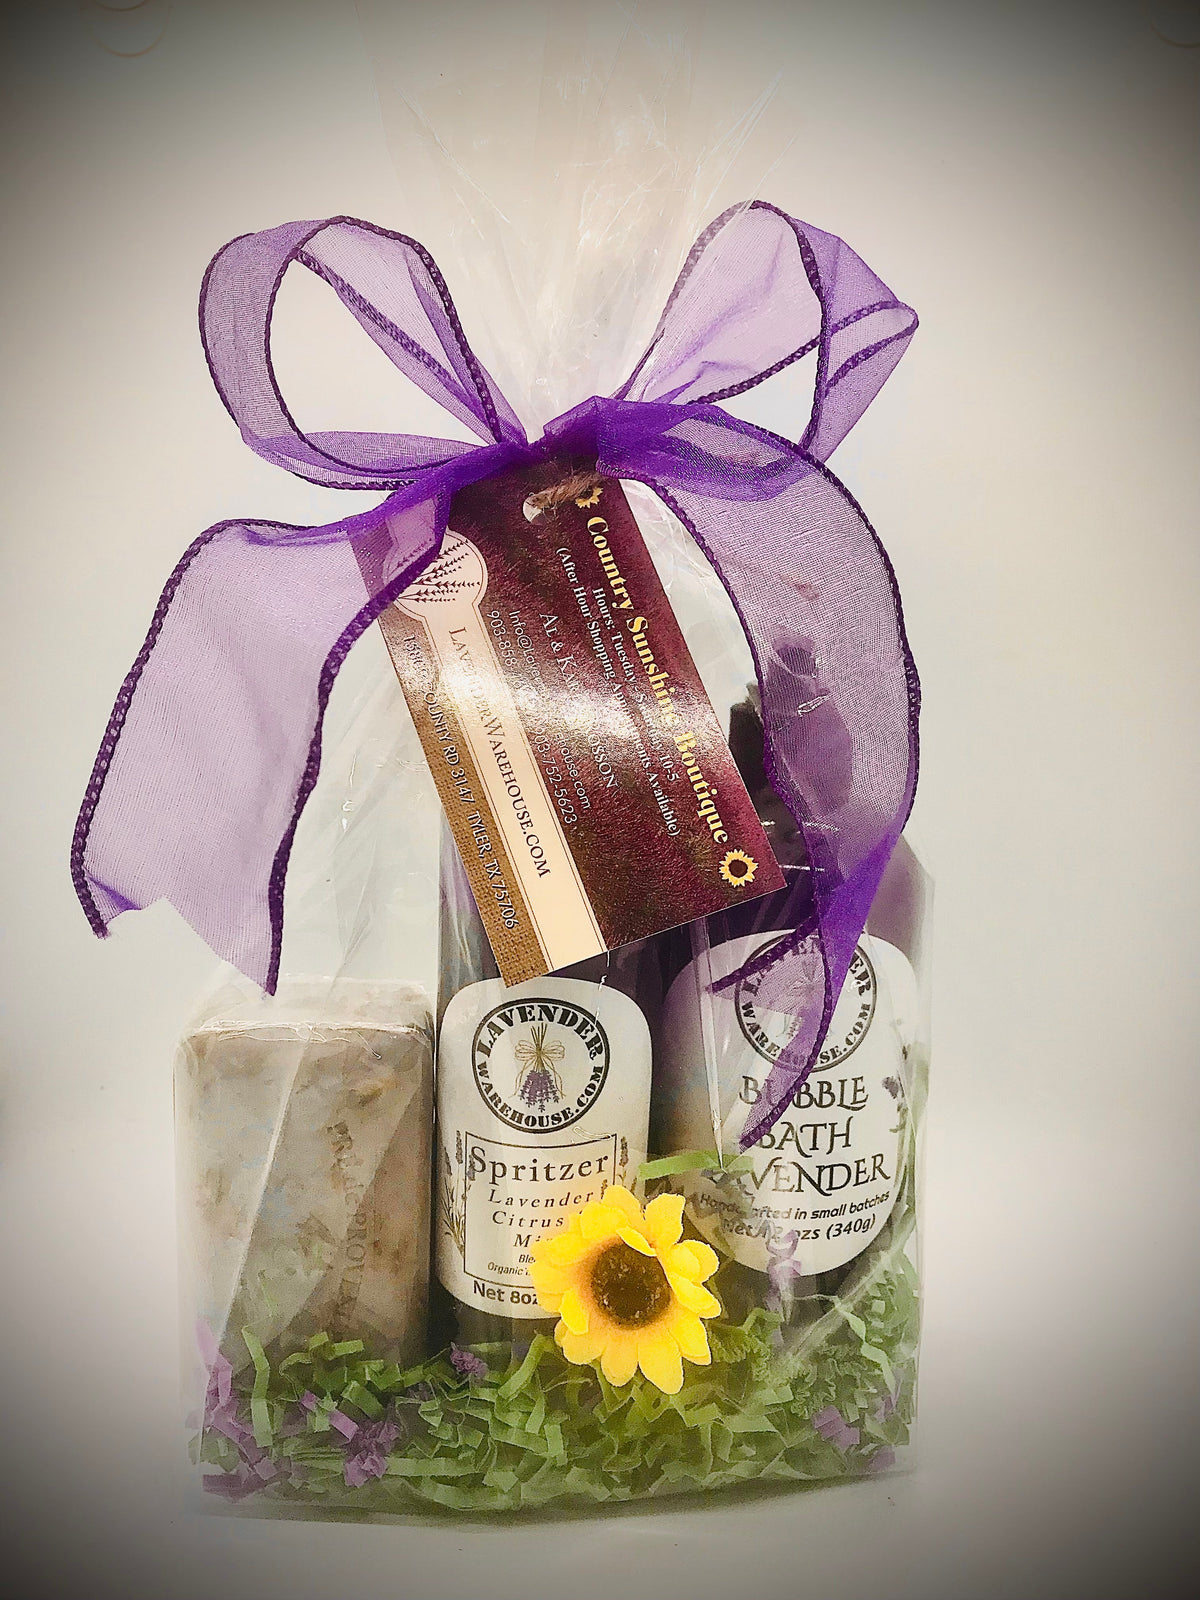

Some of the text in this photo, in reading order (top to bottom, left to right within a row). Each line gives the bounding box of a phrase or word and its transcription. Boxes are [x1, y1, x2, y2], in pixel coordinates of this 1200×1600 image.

[550, 641, 563, 653] &
[555, 547, 578, 584] (After
[572, 588, 591, 618] Hour
[586, 622, 615, 678] Shopping
[646, 773, 681, 835] Available)
[586, 514, 634, 609] Country
[672, 732, 726, 844] Boutique
[591, 588, 614, 630] Hours:
[610, 632, 636, 681] Tuesday
[659, 753, 679, 781] 10-5
[443, 745, 460, 767] RD
[451, 767, 475, 805] 3147
[466, 810, 491, 857] TYLER,
[484, 858, 501, 880] TX
[491, 879, 519, 929] 75706
[476, 1004, 604, 1061] LAVENDER
[477, 1060, 604, 1128] WAREHOUSE.COM
[470, 1145, 609, 1186] Spritzer
[488, 1188, 594, 1208] Lavender
[794, 1207, 808, 1220] in
[810, 1203, 848, 1220] small
[849, 1190, 890, 1214] batches
[492, 1210, 564, 1228] Citrus
[826, 1213, 876, 1240] (340g)
[487, 1261, 524, 1276] Organic
[473, 1280, 505, 1302] Net
